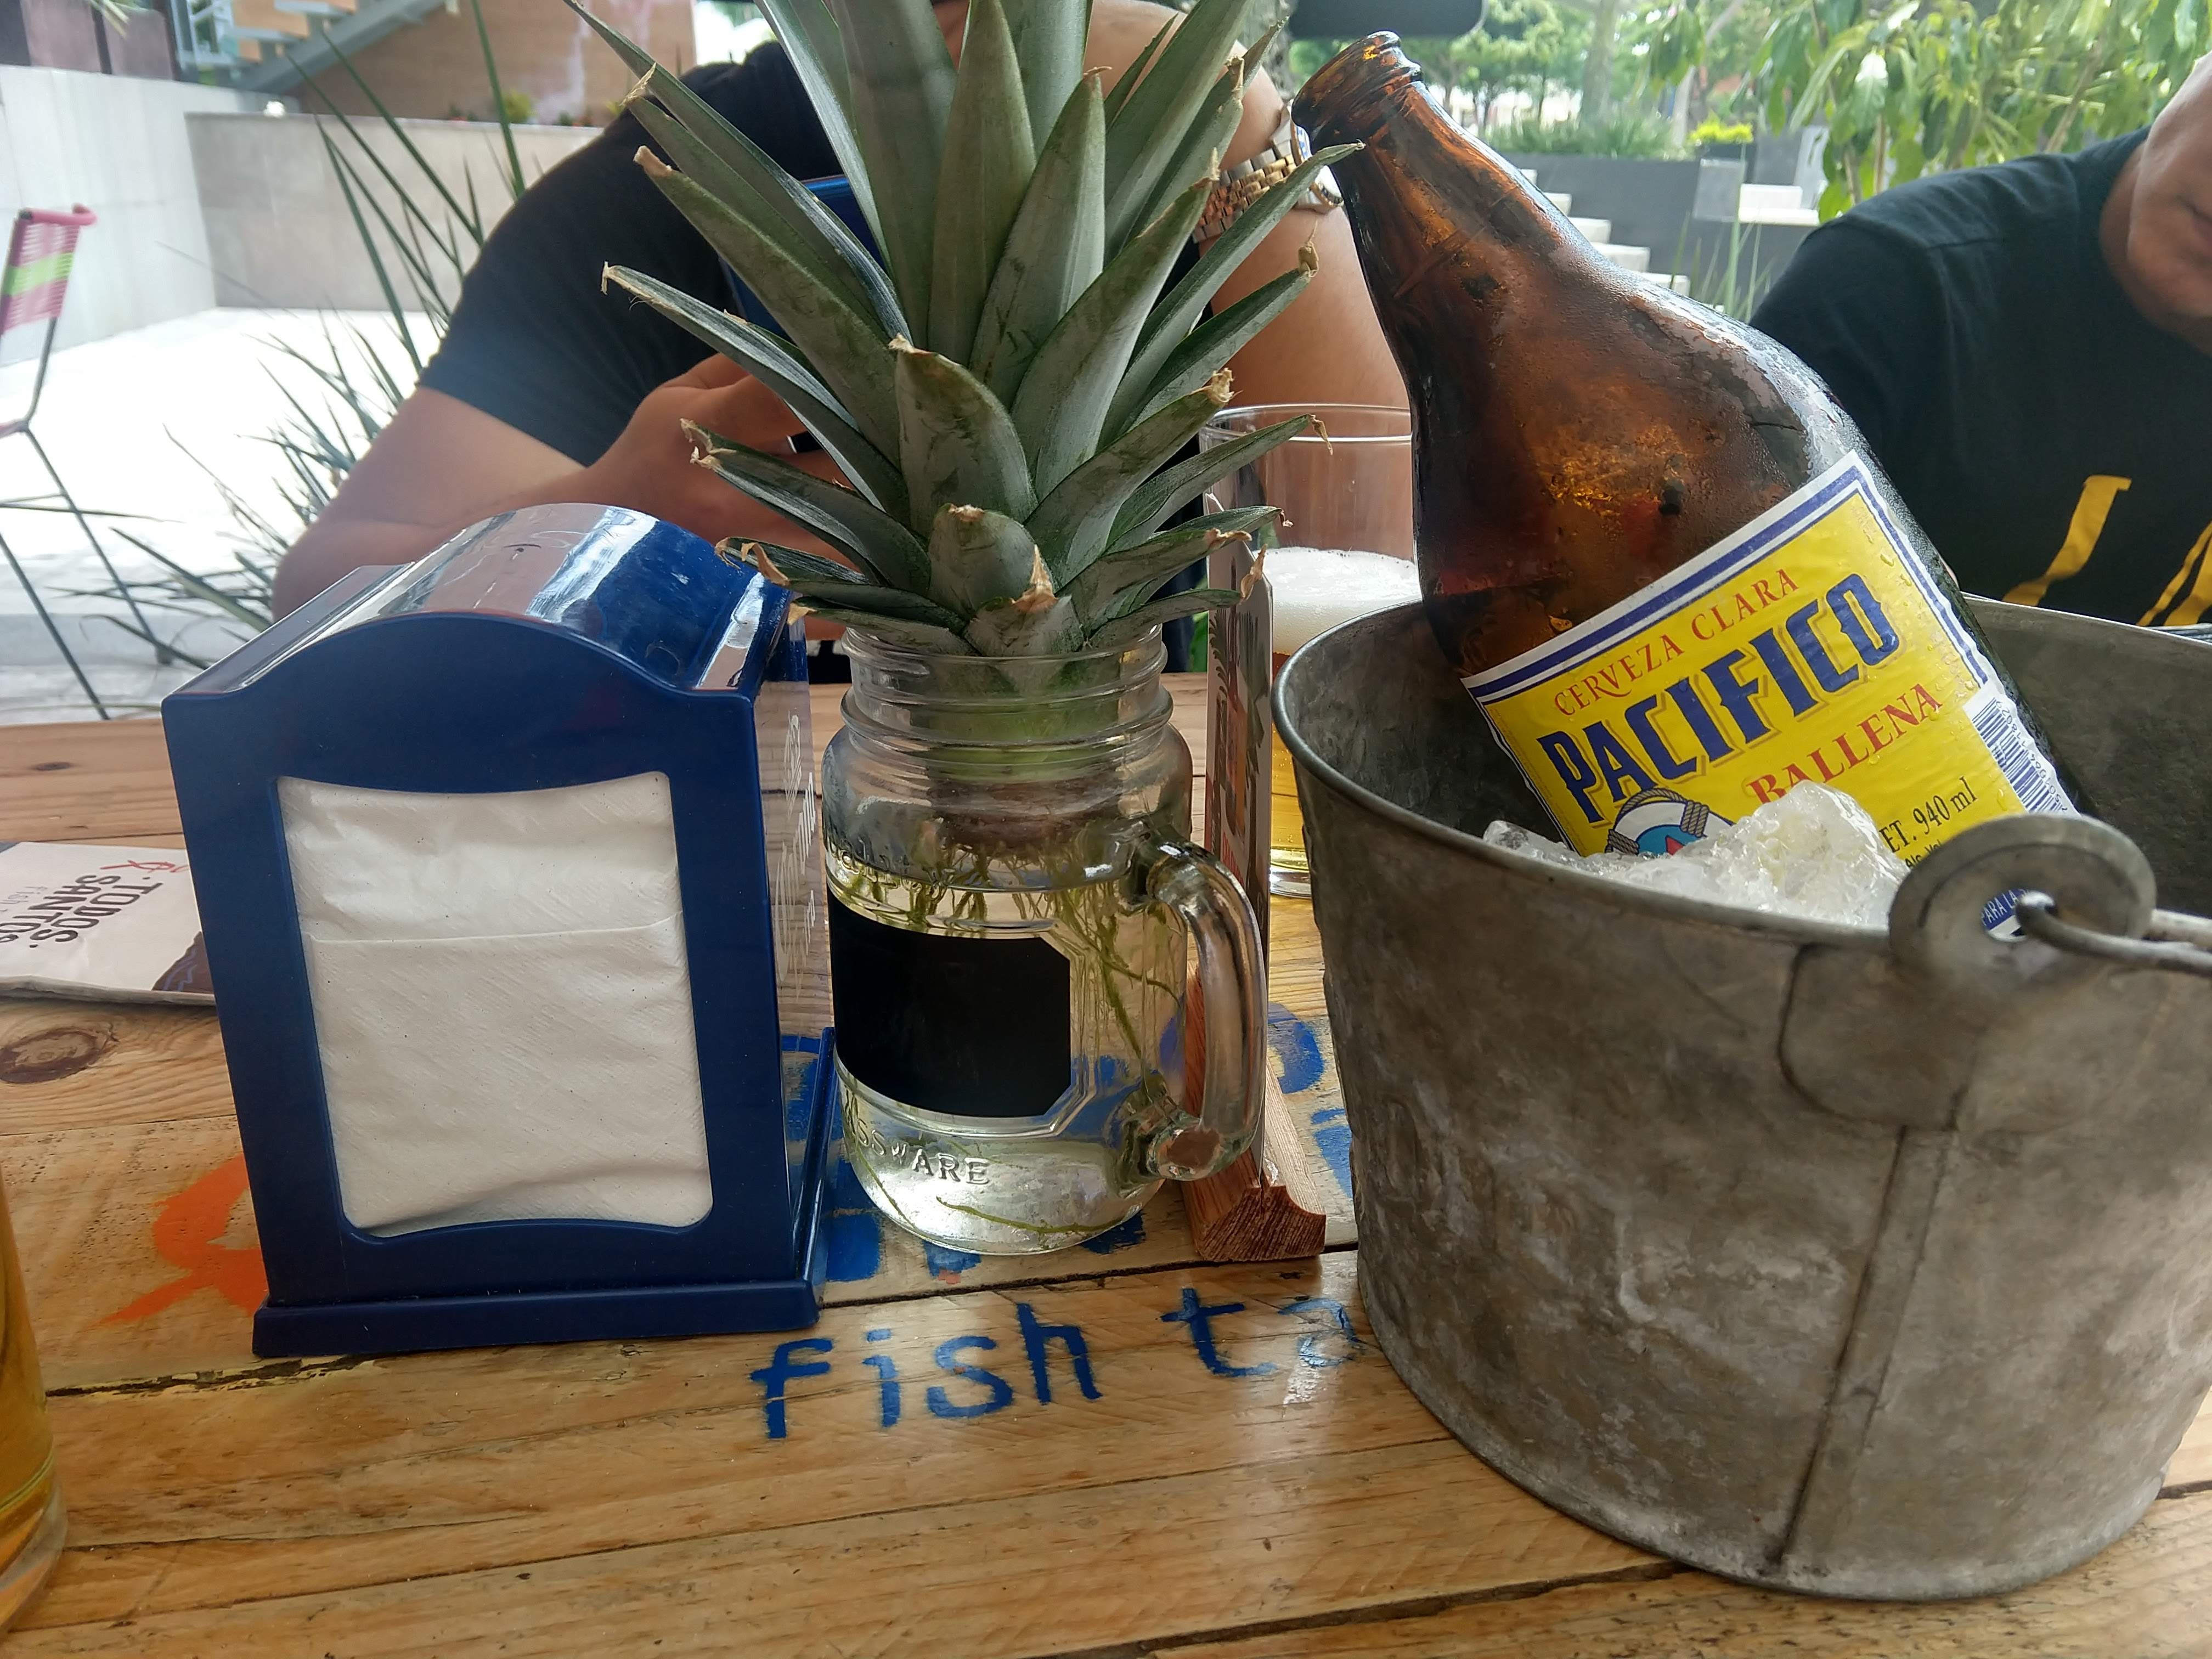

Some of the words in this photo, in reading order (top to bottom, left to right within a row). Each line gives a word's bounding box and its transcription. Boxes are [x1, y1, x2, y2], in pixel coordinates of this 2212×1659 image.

[1537, 573, 1900, 825] PACIFICO
[1555, 635, 1684, 716] CERVEZA
[1692, 569, 1799, 641] CLARA
[1747, 684, 1943, 803] BALLENA
[1911, 792, 1950, 835] 940
[1950, 776, 1978, 812] ml
[775, 772, 816, 982] Corona
[1982, 895, 2007, 926] PARA
[2002, 889, 2019, 909] LA
[749, 1301, 1102, 1440] fish
